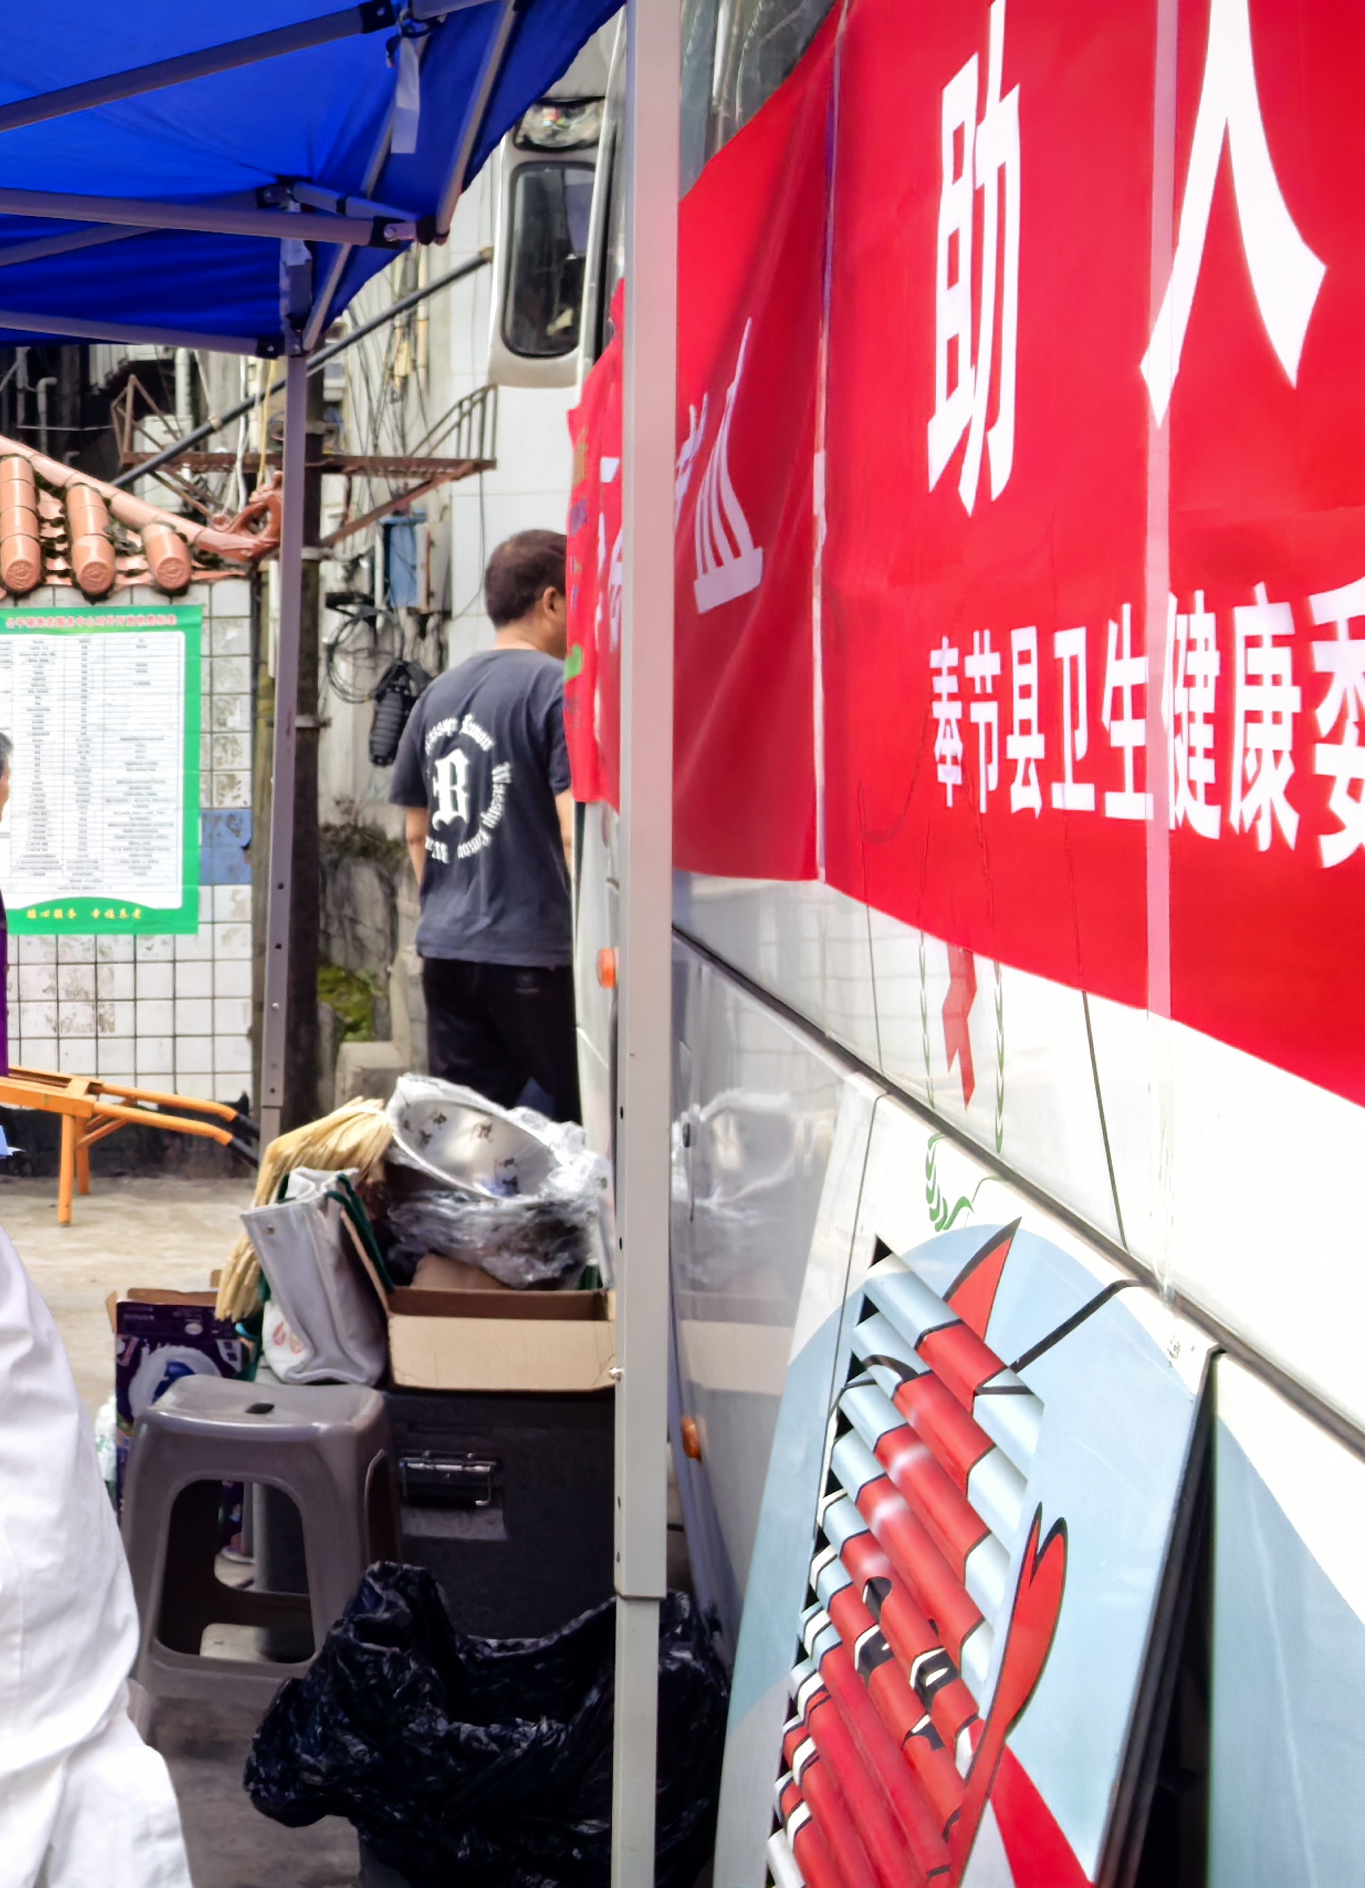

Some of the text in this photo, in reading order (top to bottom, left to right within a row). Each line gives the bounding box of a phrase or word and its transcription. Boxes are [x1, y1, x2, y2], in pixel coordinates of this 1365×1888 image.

[927, 0, 1326, 516] 助人
[930, 580, 1365, 869] 奉节县卫生健康委
